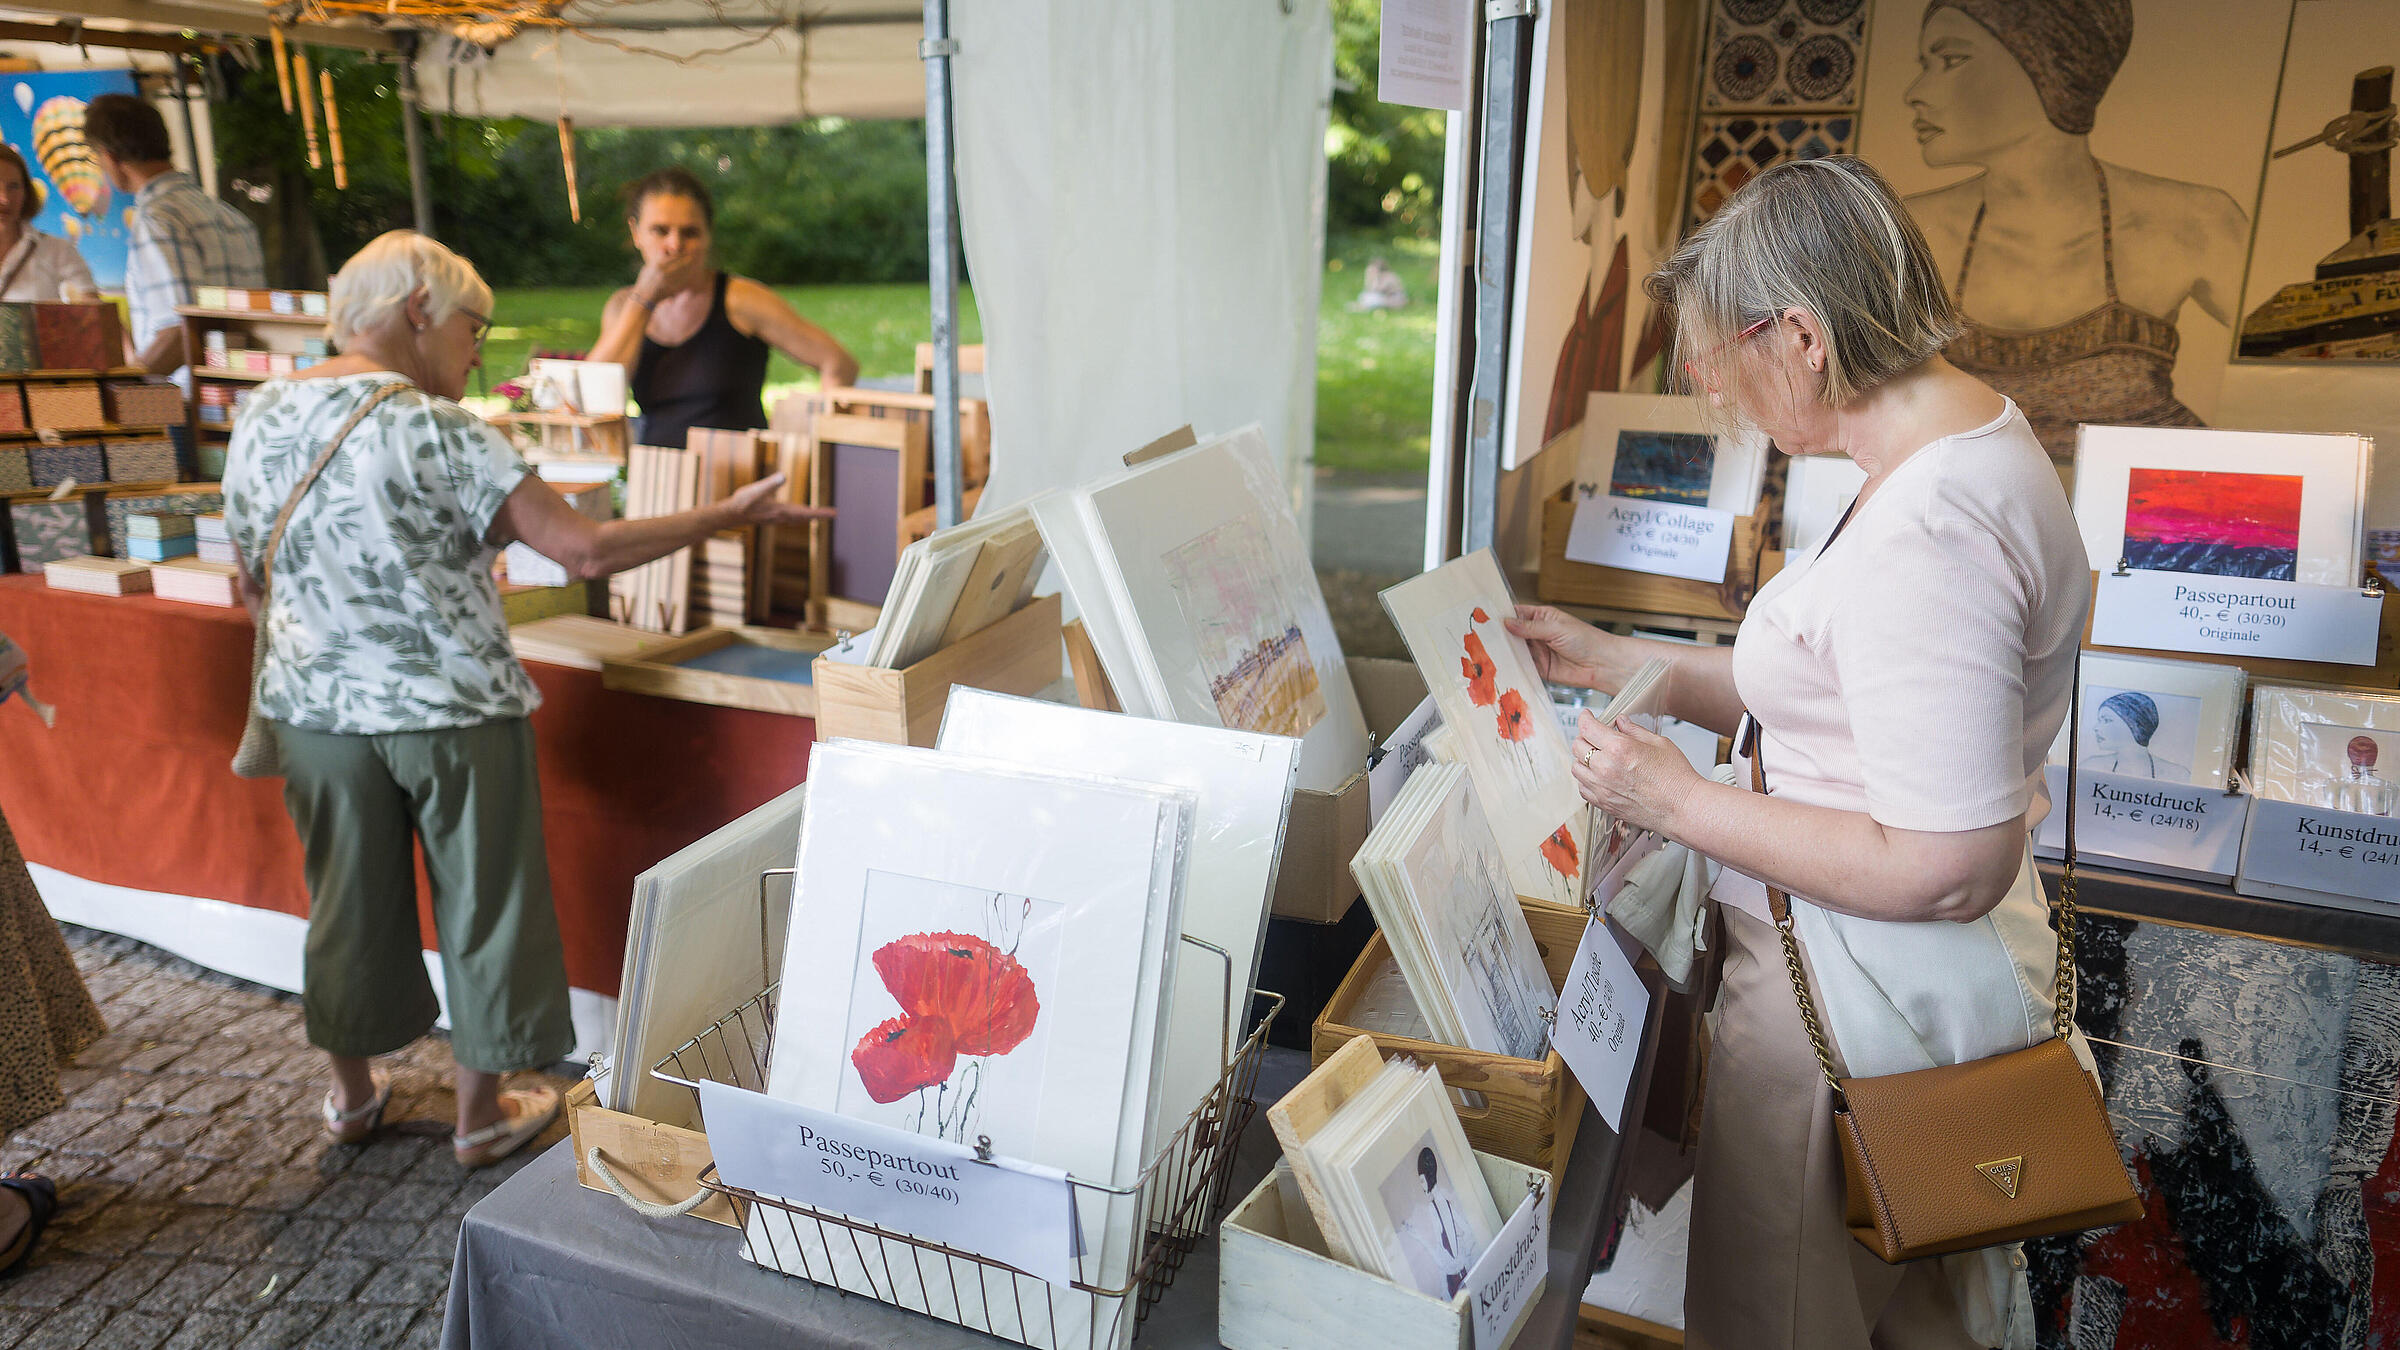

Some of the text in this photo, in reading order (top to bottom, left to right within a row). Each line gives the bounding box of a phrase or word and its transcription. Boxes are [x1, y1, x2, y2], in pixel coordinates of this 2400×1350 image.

[1646, 528, 1656, 540] €
[1631, 543, 1678, 559] Originale
[2174, 585, 2296, 609] Passepartout
[2179, 605, 2286, 628] 40,- € (30/30)
[2199, 626, 2260, 641] Originale
[2092, 782, 2208, 814] Kunstdruck
[2093, 802, 2200, 832] 14,- € (24/18)
[2296, 816, 2400, 847] Kunstdru
[2298, 838, 2400, 865] 14,- € (24/1
[1598, 1003, 1609, 1021] €
[1608, 1012, 1626, 1053] Originale
[798, 1125, 960, 1181] Passepartout
[1990, 1163, 2017, 1174] GUESS
[820, 1157, 959, 1206] 50,- € (30/40)
[1479, 1214, 1541, 1317] Kunstdruck
[1502, 1291, 1511, 1312] €
